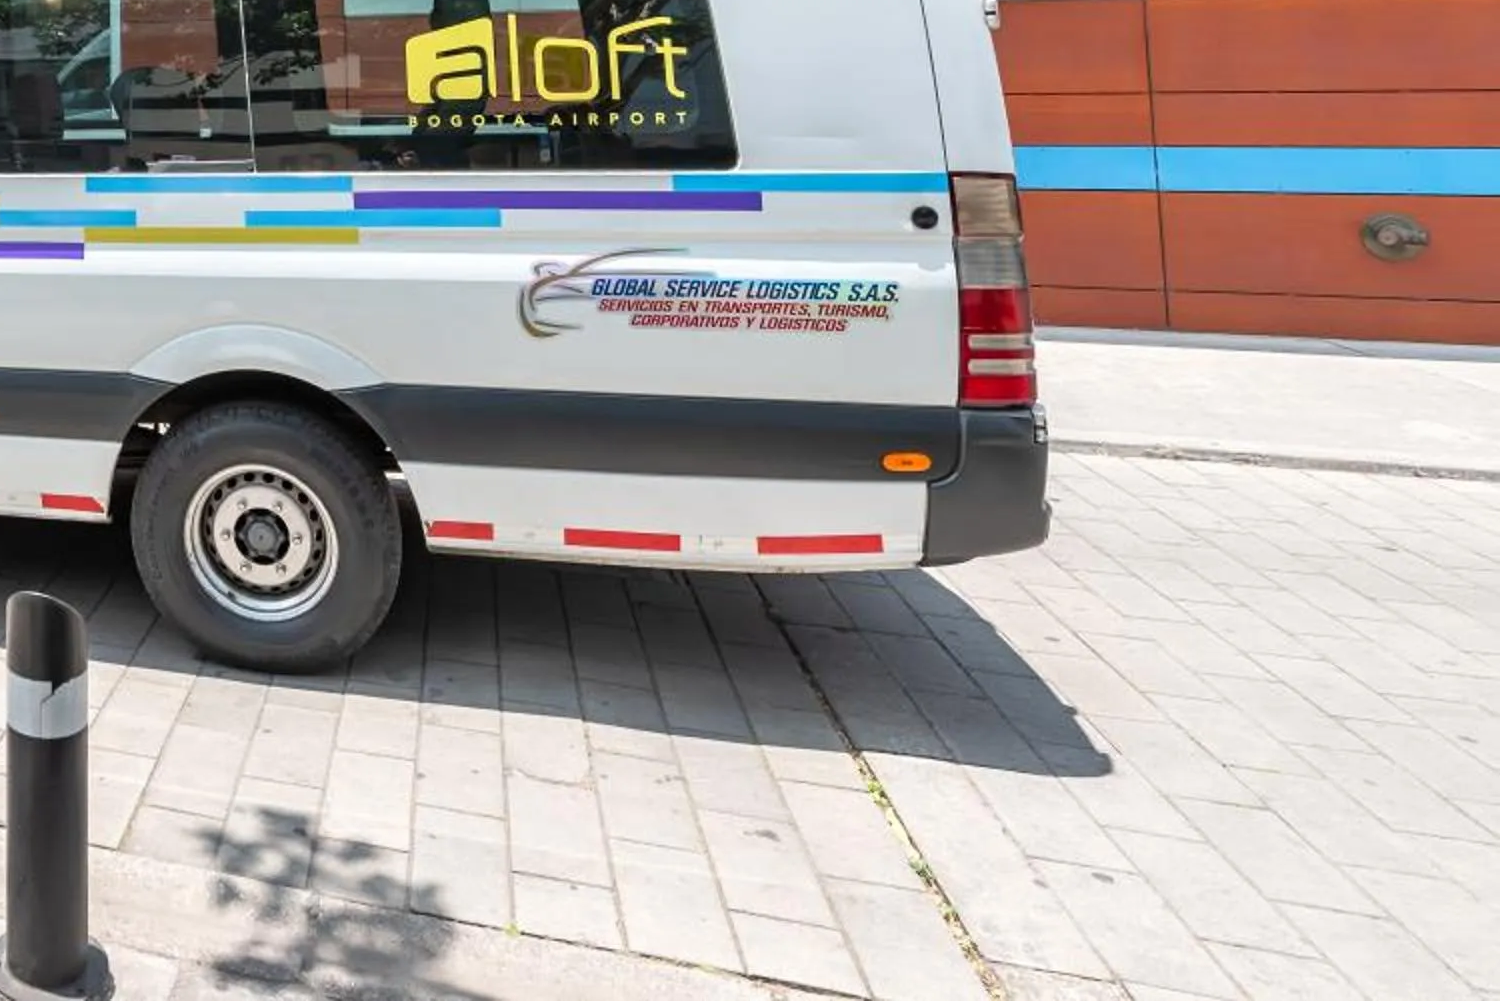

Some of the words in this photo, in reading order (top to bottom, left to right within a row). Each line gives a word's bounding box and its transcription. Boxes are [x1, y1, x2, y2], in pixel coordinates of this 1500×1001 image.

[405, 12, 687, 103] aloft
[408, 114, 525, 128] BOGOTA
[550, 111, 687, 127] AIRPORT
[591, 278, 657, 296] GLOBAL
[664, 280, 743, 298] SERVICE
[746, 281, 840, 300] LOGISTICS
[848, 283, 900, 302] S.A.S.
[599, 298, 673, 312] SERVICIOS
[678, 300, 699, 313] EN
[705, 300, 812, 317] TRANSPORTES,
[818, 303, 890, 320] TURISMO,
[630, 313, 741, 328] CORPORATIVOS
[745, 316, 757, 329] Y
[759, 316, 848, 332] LOGISTICOS
